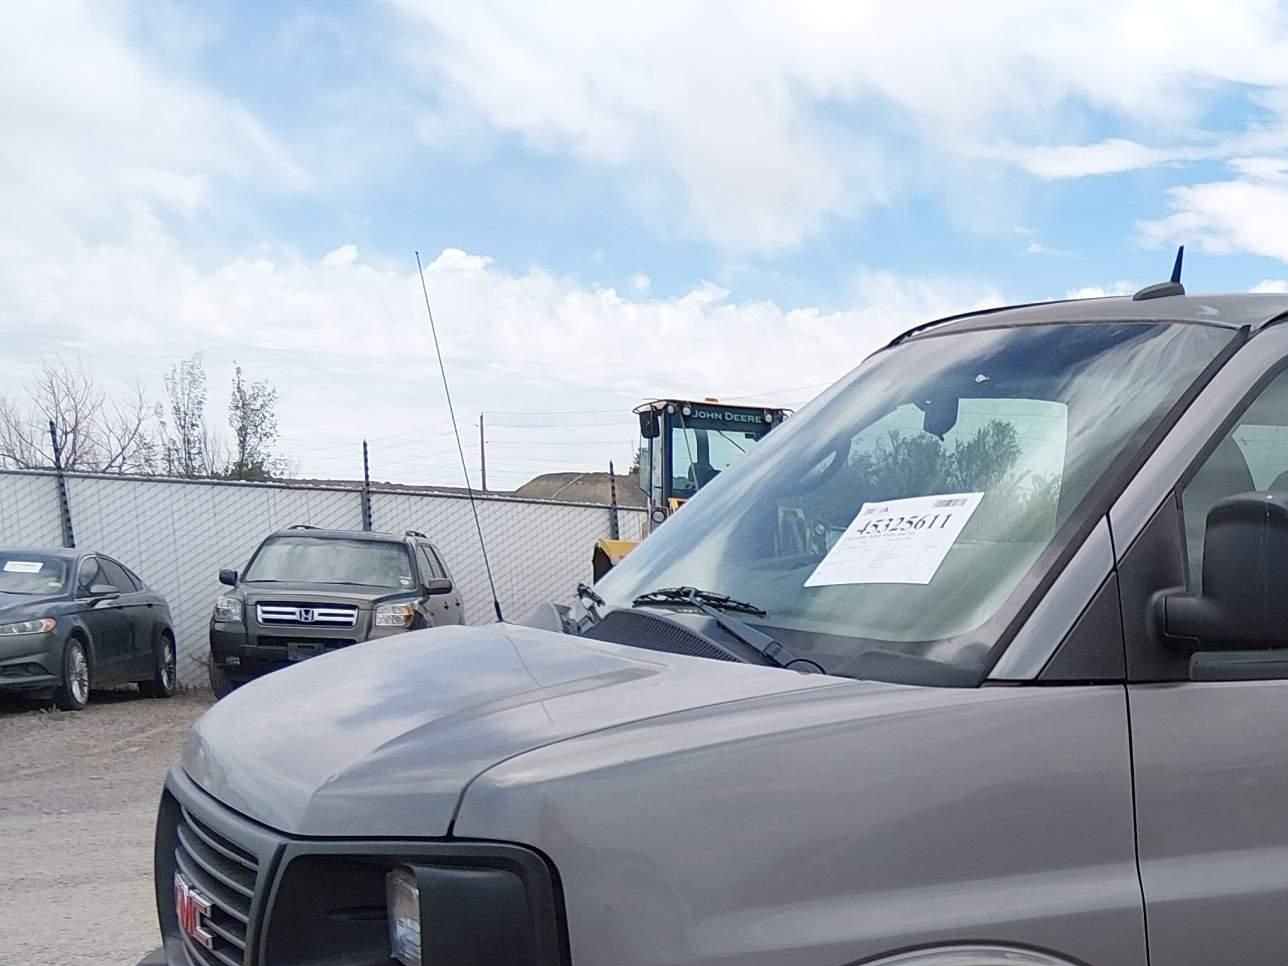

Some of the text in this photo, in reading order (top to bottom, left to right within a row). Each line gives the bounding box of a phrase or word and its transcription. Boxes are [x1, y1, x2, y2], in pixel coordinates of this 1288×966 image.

[691, 409, 762, 423] JOHN DEERE
[857, 513, 953, 535] 45325611
[175, 871, 213, 950] MC
